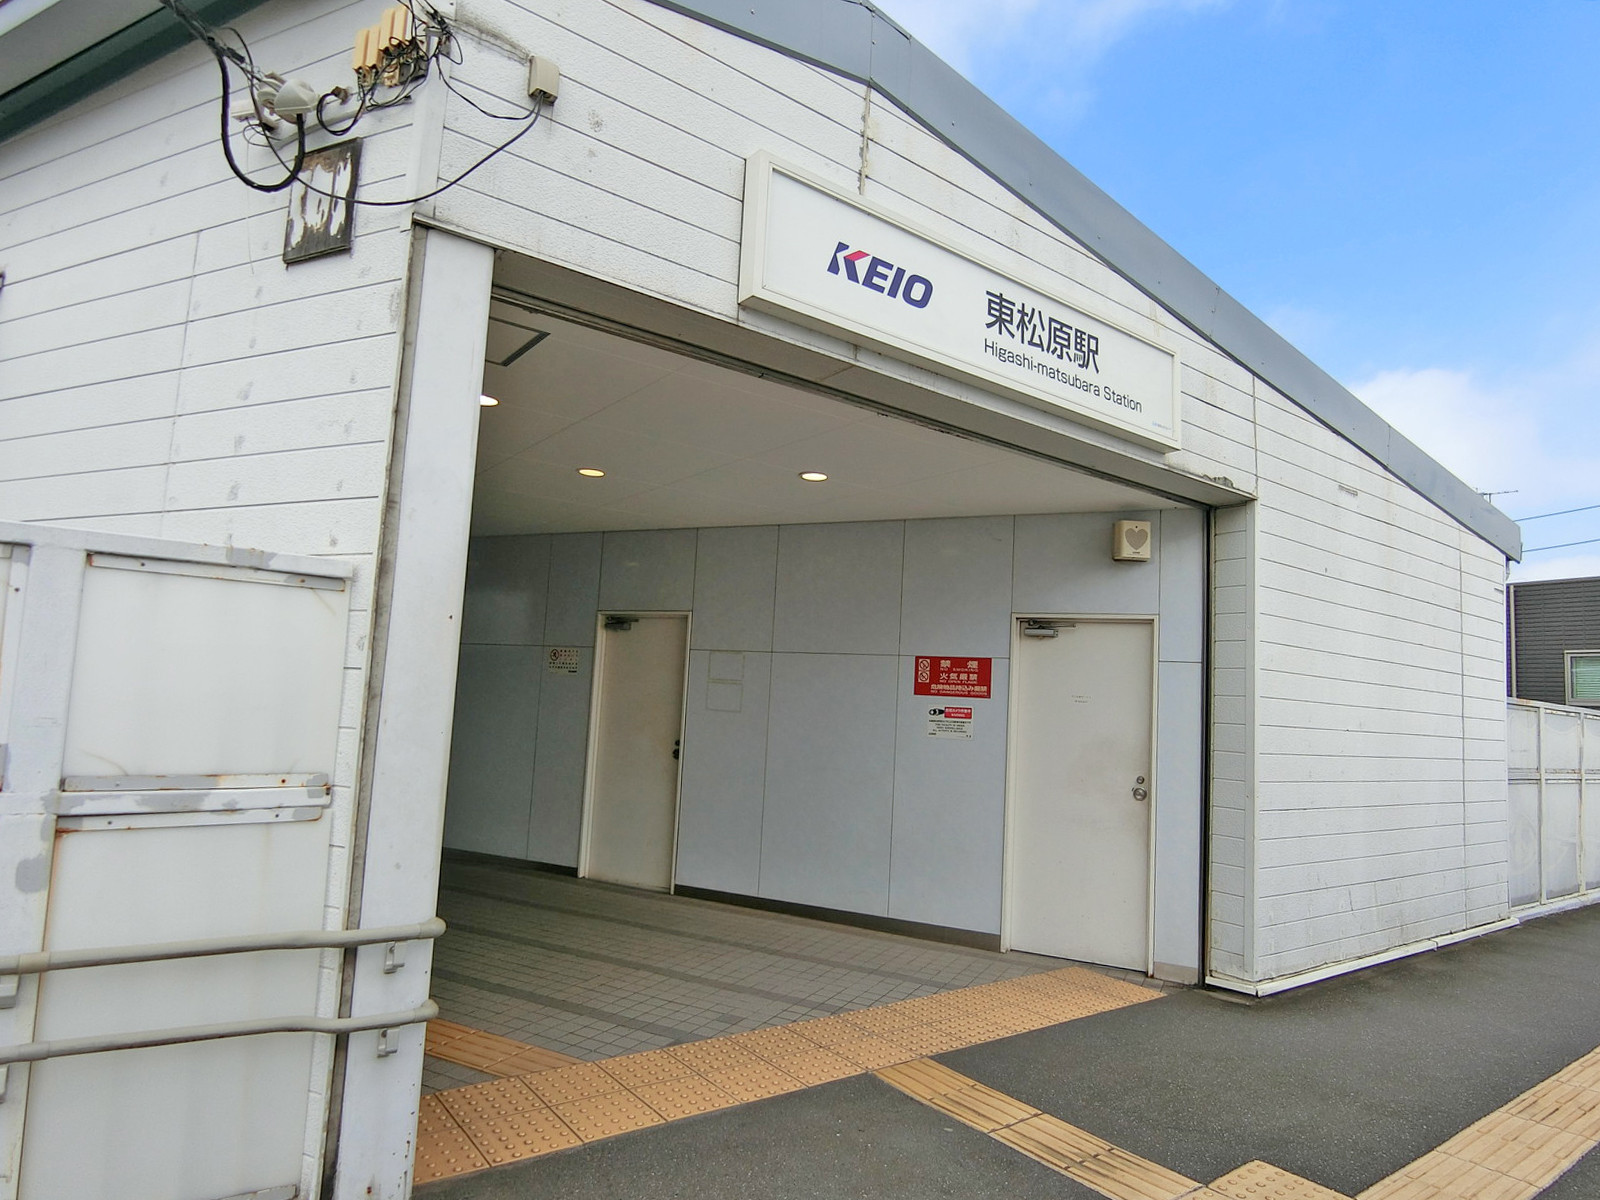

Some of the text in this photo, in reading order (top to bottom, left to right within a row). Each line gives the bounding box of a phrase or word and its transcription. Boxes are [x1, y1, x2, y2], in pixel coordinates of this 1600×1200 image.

[827, 241, 934, 309] KEIO
[985, 290, 1100, 374] 東松原駅
[984, 338, 1143, 413] Higashi-matsubara Station
[940, 672, 978, 680] 火気厳禁
